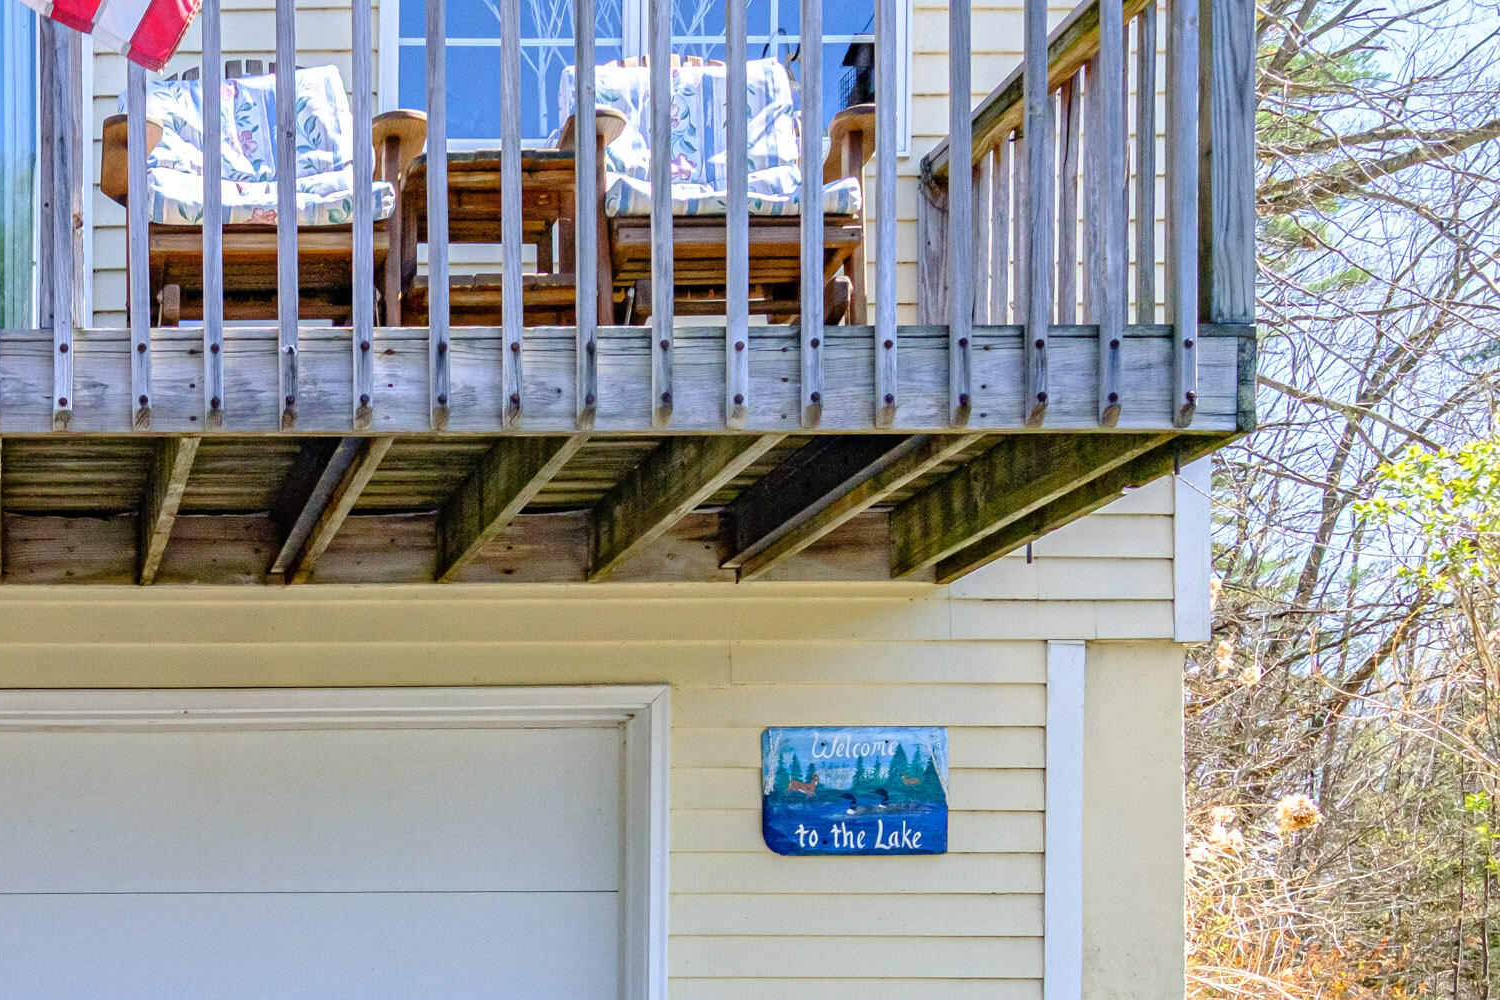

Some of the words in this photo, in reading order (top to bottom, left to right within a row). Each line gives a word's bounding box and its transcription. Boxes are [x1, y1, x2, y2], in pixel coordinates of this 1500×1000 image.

[811, 731, 898, 759] Welcome
[794, 823, 819, 848] to
[830, 821, 866, 849] the
[874, 819, 923, 850] Lake
